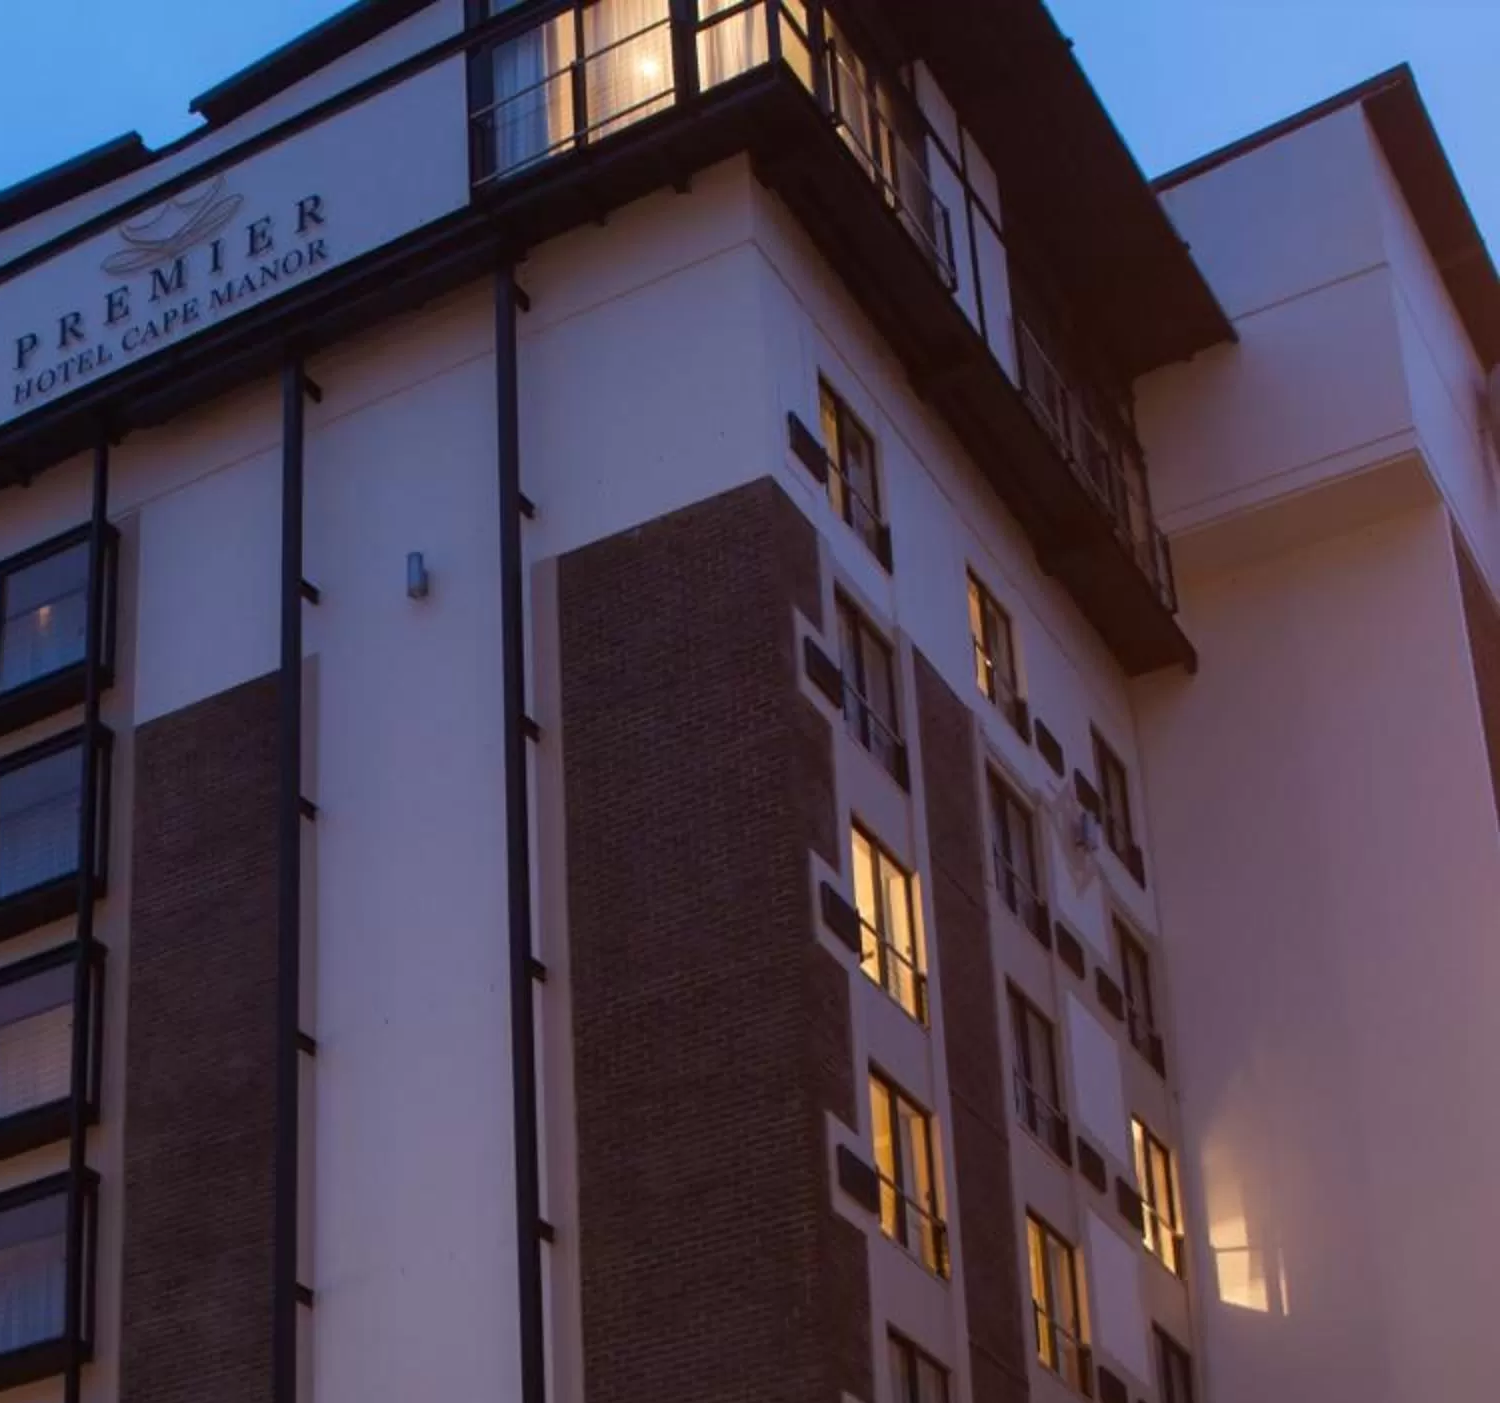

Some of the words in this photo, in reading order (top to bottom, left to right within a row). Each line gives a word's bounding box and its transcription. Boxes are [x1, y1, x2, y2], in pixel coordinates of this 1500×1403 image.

[12, 193, 327, 371] PREMIER
[13, 342, 113, 404] HOTEL
[121, 297, 201, 353] CAPE
[208, 237, 330, 311] MANOR
